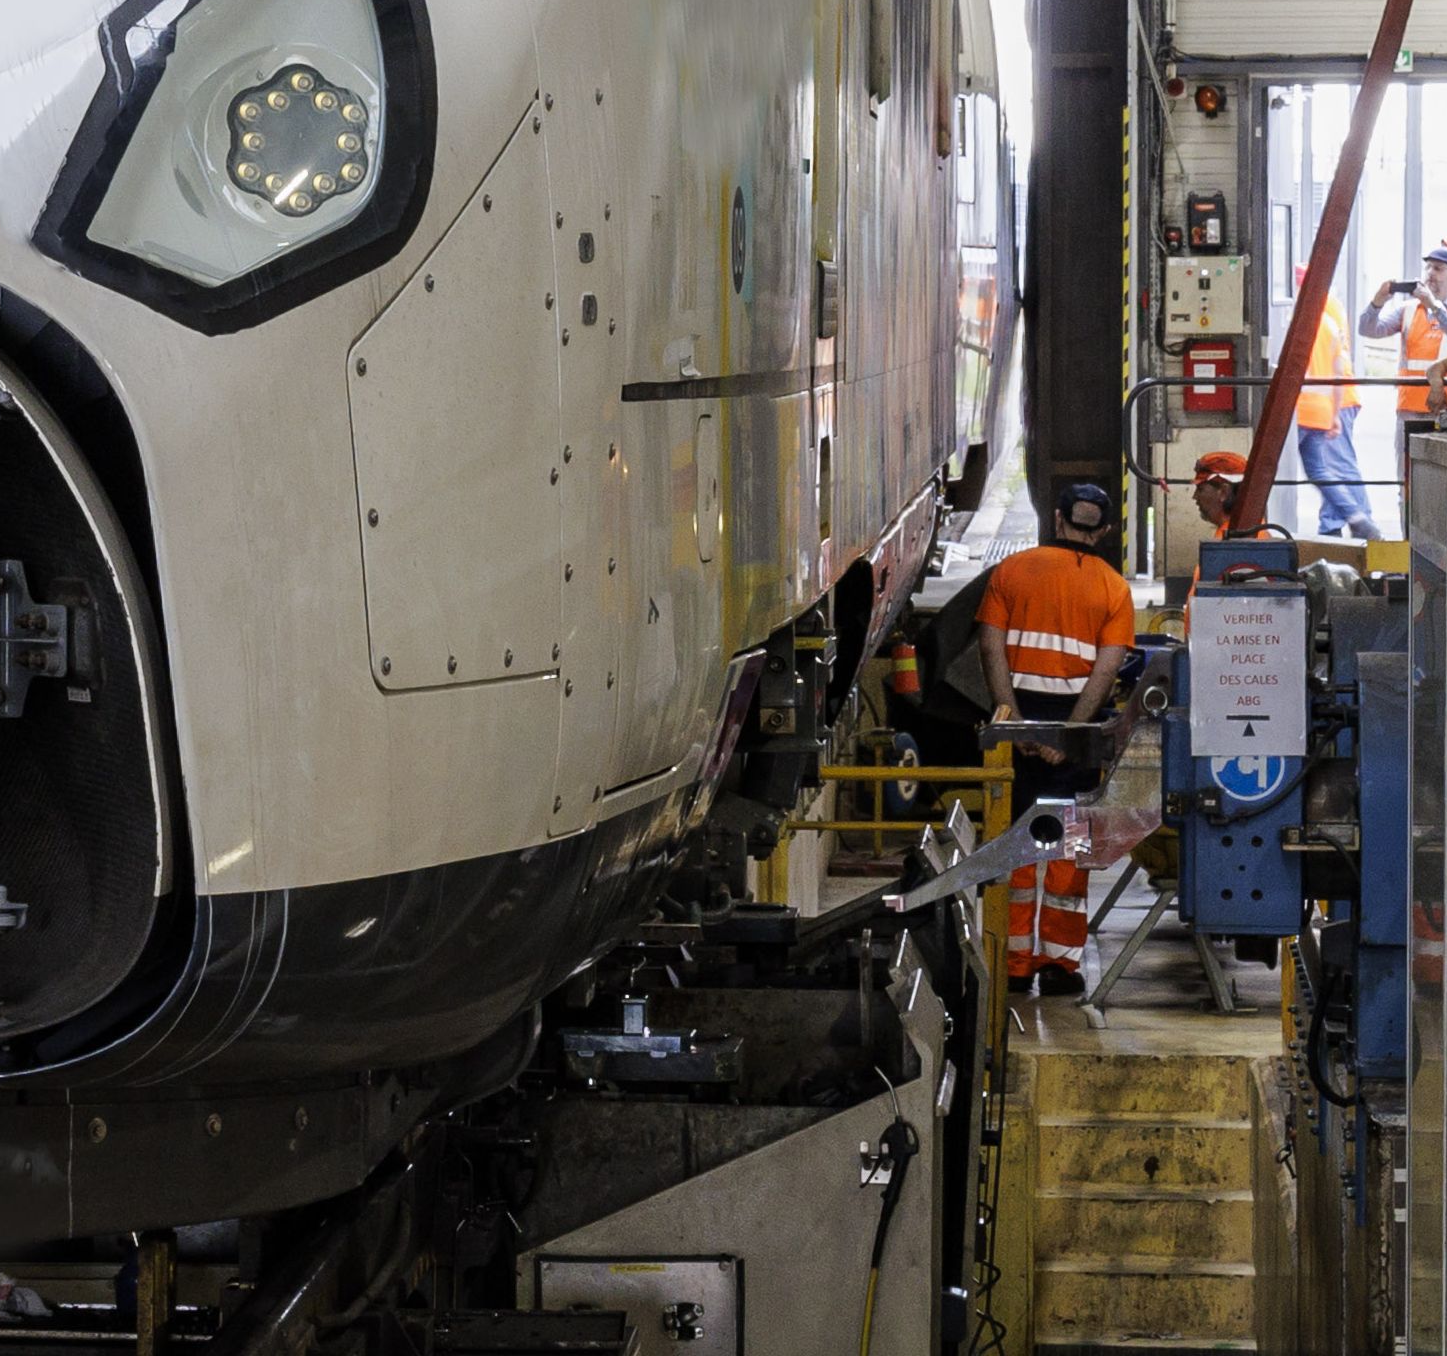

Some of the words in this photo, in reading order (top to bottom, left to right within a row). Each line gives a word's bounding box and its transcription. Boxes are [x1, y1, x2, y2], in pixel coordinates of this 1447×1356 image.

[1223, 614, 1273, 625] VERIFIER
[1216, 635, 1231, 646] LA
[1233, 635, 1261, 646] MISE
[1264, 635, 1281, 646] EN
[1231, 654, 1266, 665] PLACE
[1219, 675, 1241, 686] DES
[1244, 675, 1279, 686] CALES
[1236, 695, 1262, 707] ABG
